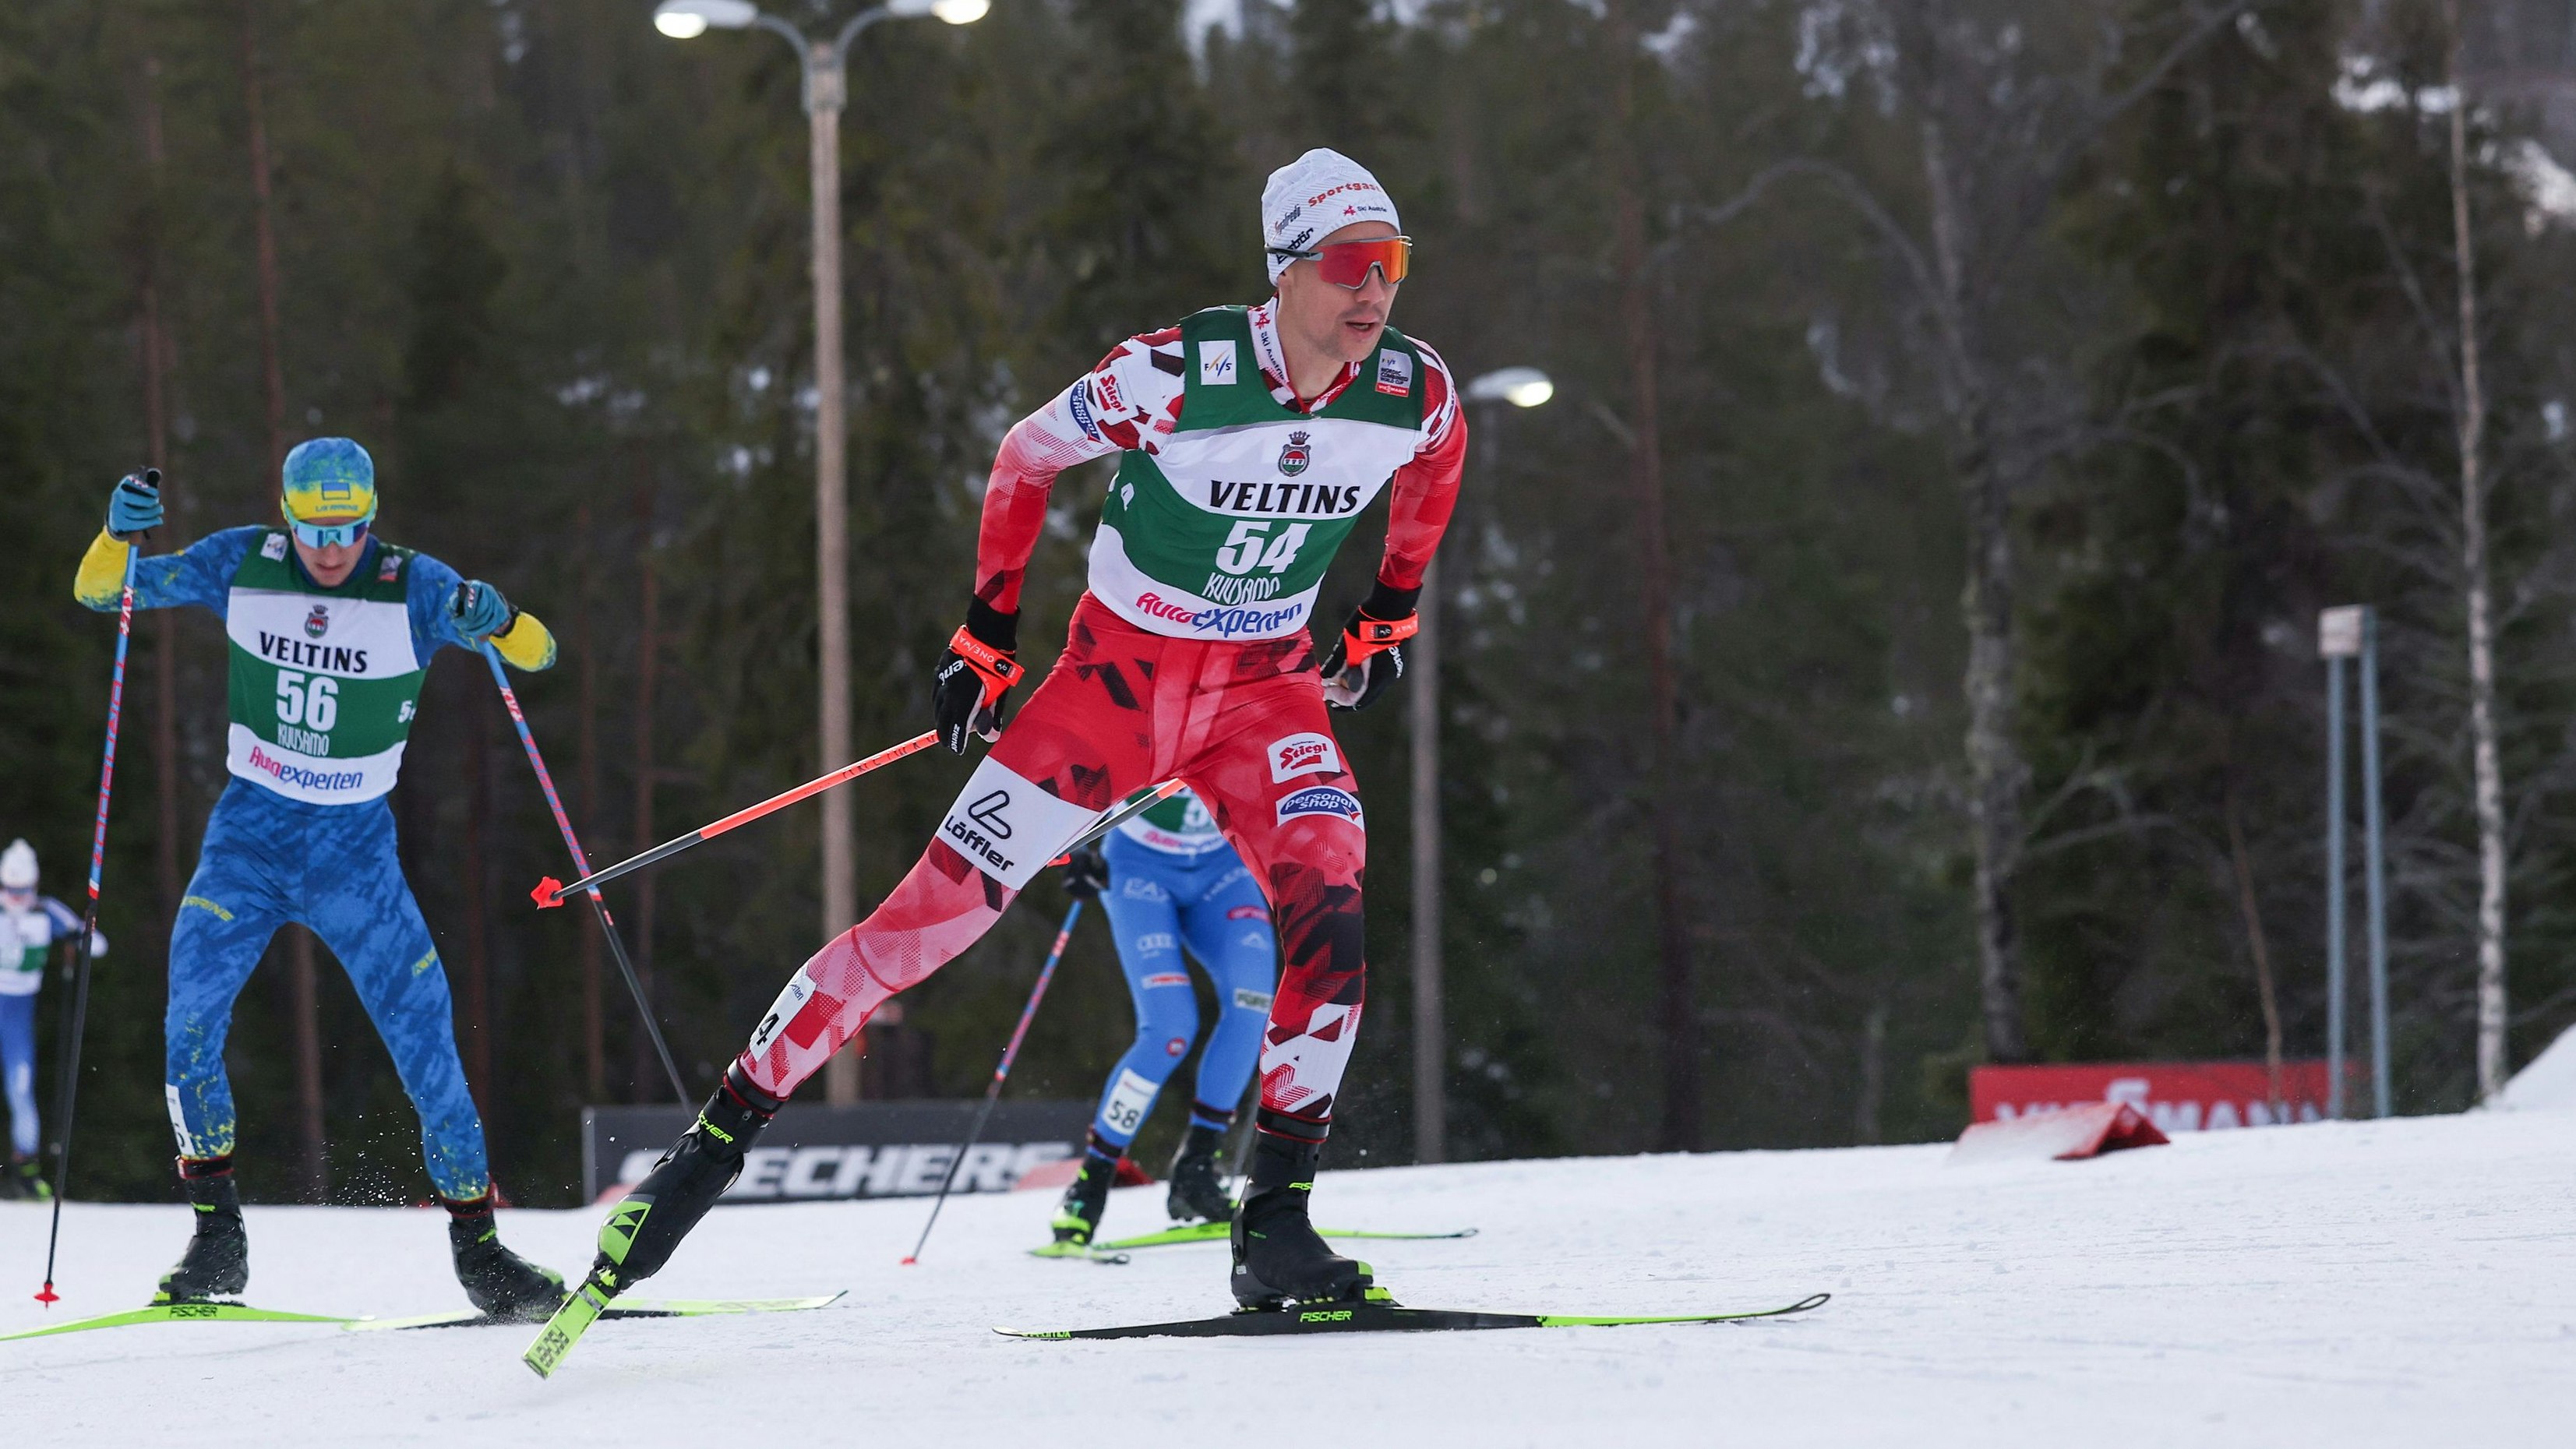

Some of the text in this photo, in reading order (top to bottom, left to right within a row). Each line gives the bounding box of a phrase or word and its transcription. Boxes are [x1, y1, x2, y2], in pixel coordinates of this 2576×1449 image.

[1210, 480, 1360, 514] VELTINS
[1215, 520, 1313, 575] 54
[1202, 572, 1280, 605] KUUSAMO
[259, 631, 368, 673] VELTINS
[276, 669, 339, 732] 56
[277, 723, 330, 756] KUUSAMO
[249, 746, 363, 790] Autoexperten
[1279, 743, 1328, 770] Stiegl
[1285, 793, 1353, 811] personal
[1298, 799, 1339, 809] shop
[944, 815, 1015, 872] Löffler
[1108, 1100, 1140, 1129] 58
[1299, 1310, 1353, 1323] FISCHER
